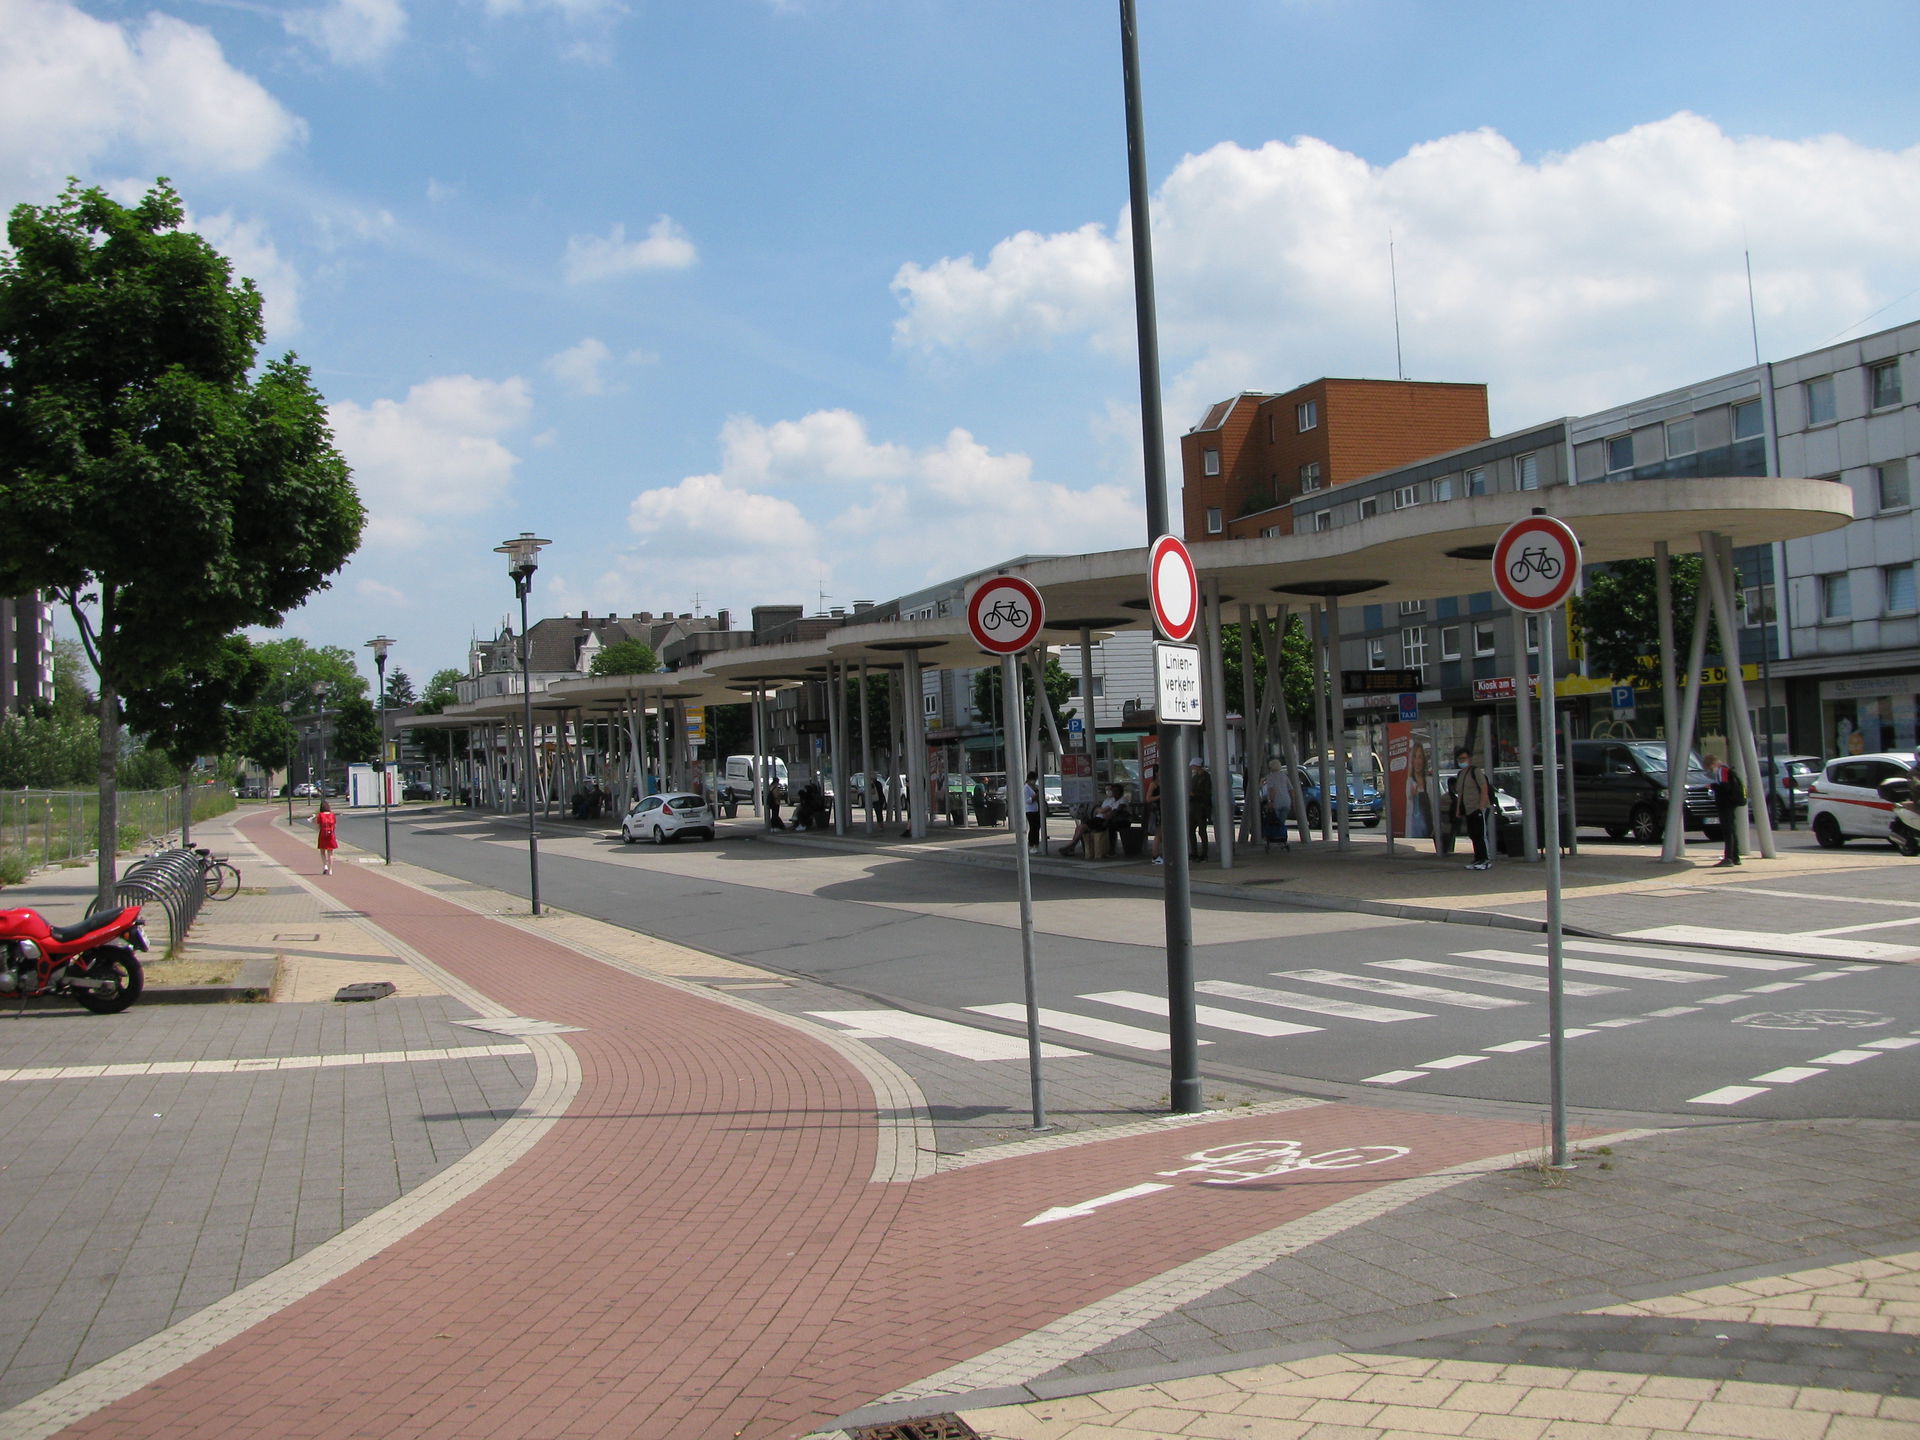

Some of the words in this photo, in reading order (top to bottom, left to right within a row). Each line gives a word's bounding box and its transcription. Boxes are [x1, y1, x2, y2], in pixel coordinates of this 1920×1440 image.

[1165, 653, 1192, 671] Linien-
[1164, 676, 1195, 692] verkehr
[1478, 680, 1497, 690] Kiosk
[1498, 680, 1510, 689] am
[1363, 696, 1392, 707] Kiosk
[1616, 689, 1628, 706] P
[1175, 697, 1188, 713] frei
[1401, 711, 1417, 719] TAXI
[1071, 720, 1079, 731] P
